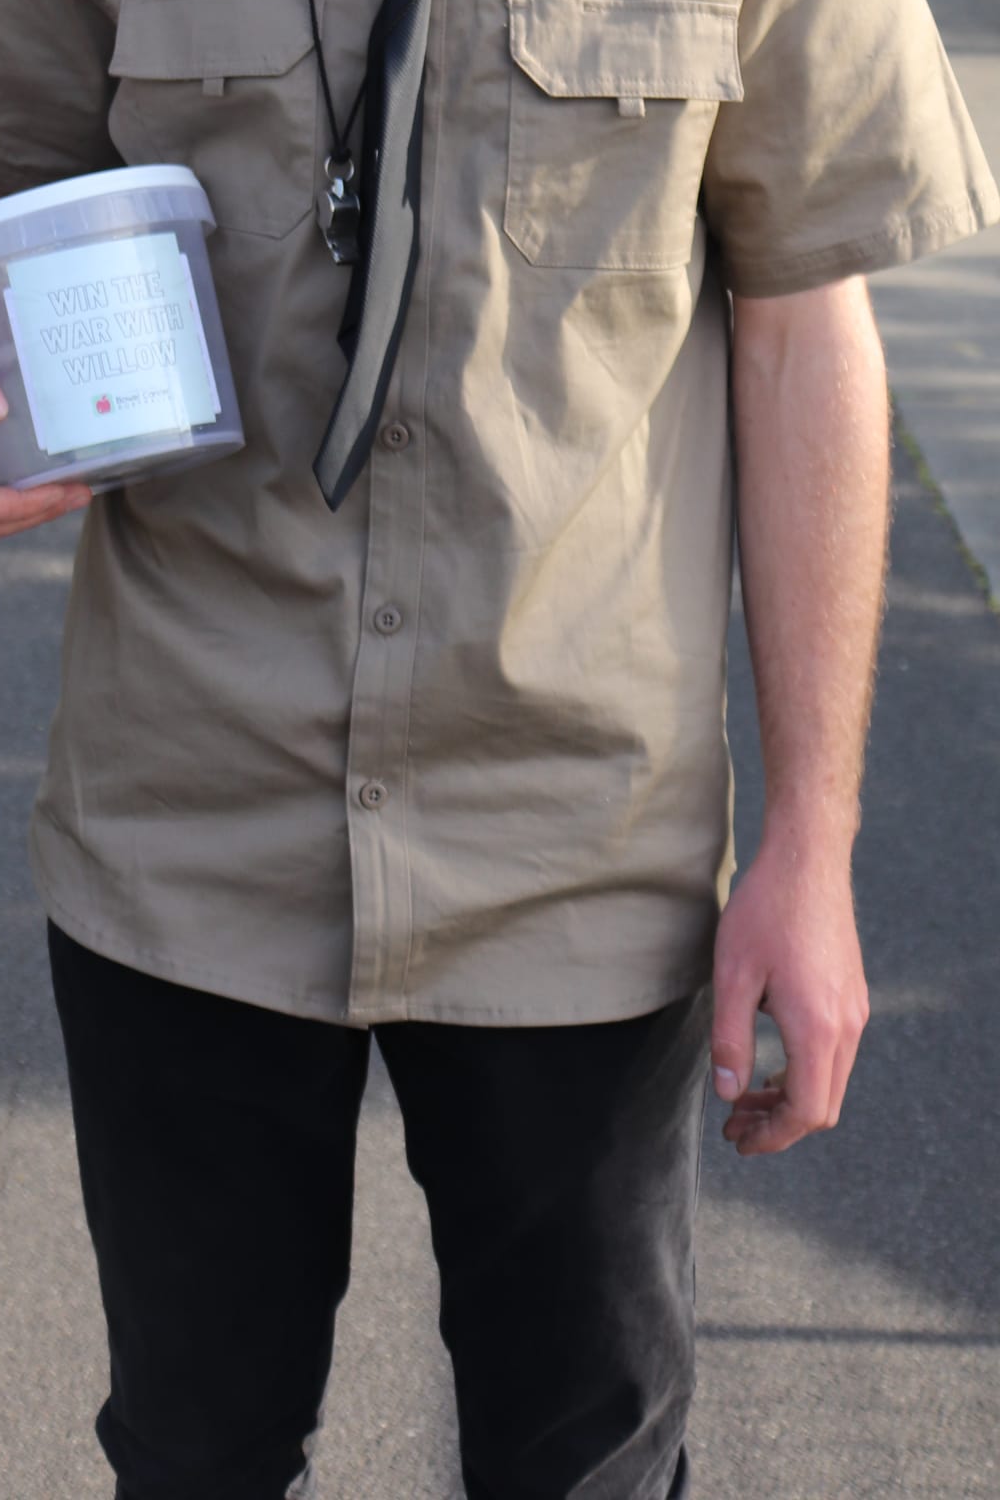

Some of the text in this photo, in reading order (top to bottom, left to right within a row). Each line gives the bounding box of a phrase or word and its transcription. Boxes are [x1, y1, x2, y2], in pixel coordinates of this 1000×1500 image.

[47, 270, 165, 317] WIN THE
[40, 302, 184, 356] WAR WITH
[62, 338, 177, 386] WILLOW
